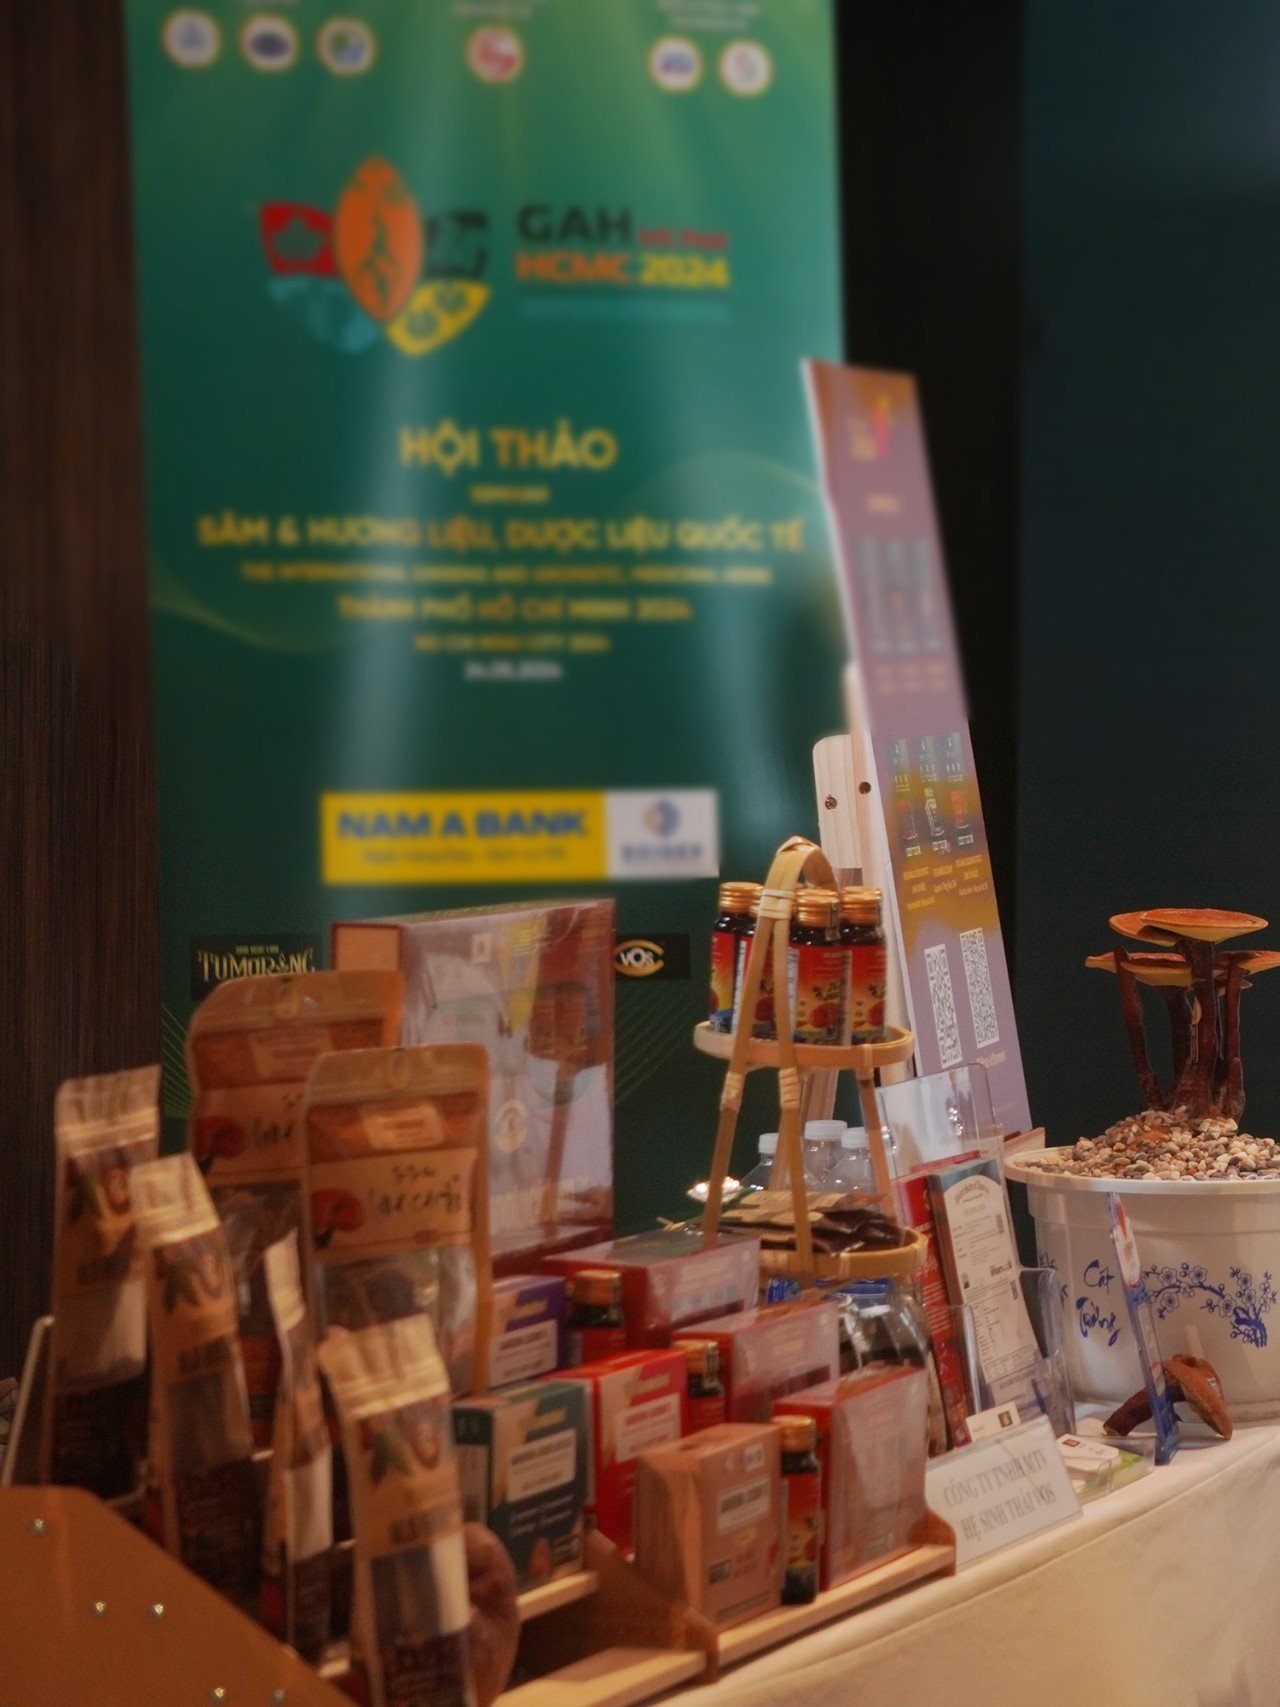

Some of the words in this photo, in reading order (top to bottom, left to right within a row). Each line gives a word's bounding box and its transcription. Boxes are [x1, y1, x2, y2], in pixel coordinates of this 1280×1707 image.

[517, 203, 632, 244] GAH
[516, 250, 631, 284] HCMC
[640, 252, 730, 289] 2024
[399, 420, 480, 478] HỘI
[491, 418, 619, 470] THẢO
[198, 510, 269, 546] SÂM
[277, 515, 299, 546] &
[676, 514, 764, 552] QUỐC
[771, 514, 805, 552] TẾ
[337, 811, 431, 839] NAM
[440, 811, 466, 838] A
[475, 809, 588, 838] BANK
[944, 1477, 979, 1509] CÔNG
[975, 1471, 995, 1494] TY
